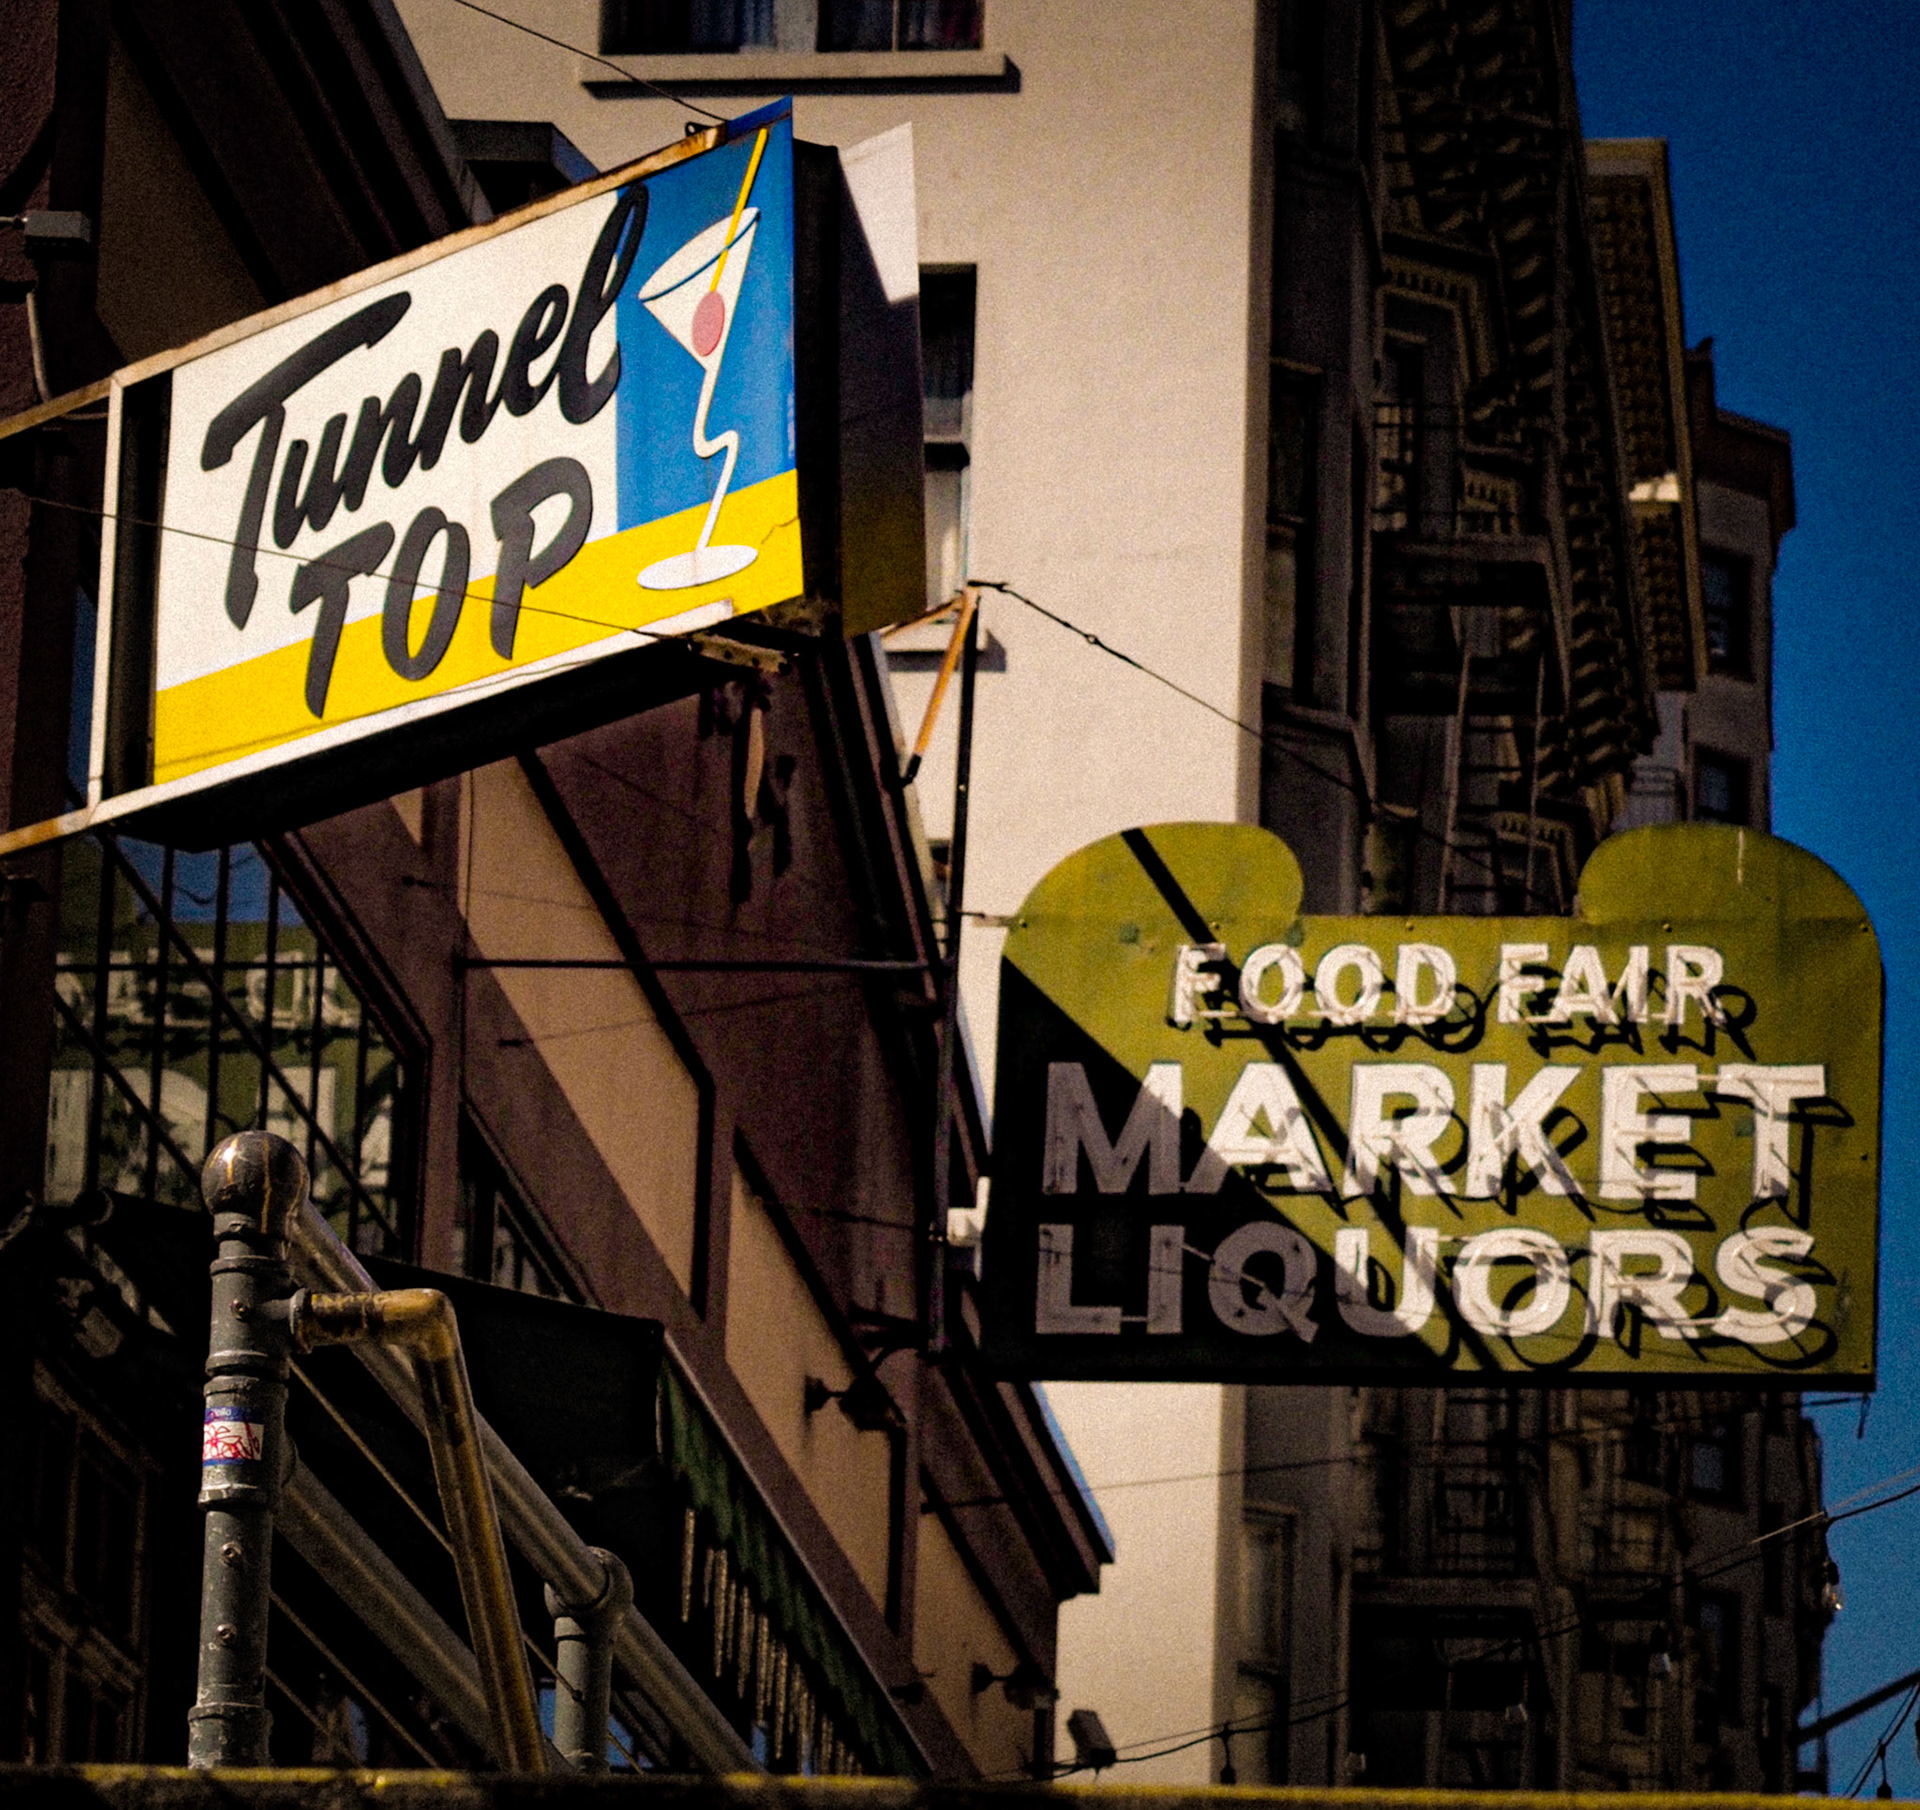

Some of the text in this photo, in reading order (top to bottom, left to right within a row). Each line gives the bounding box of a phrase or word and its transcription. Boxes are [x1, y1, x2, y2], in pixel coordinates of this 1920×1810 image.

[201, 182, 649, 631] Tunnel
[289, 457, 593, 719] TOP
[1170, 942, 1726, 1027] FOOD FAIR
[1040, 1060, 1828, 1200] MARKET
[1034, 1224, 1818, 1344] LIQUORS
